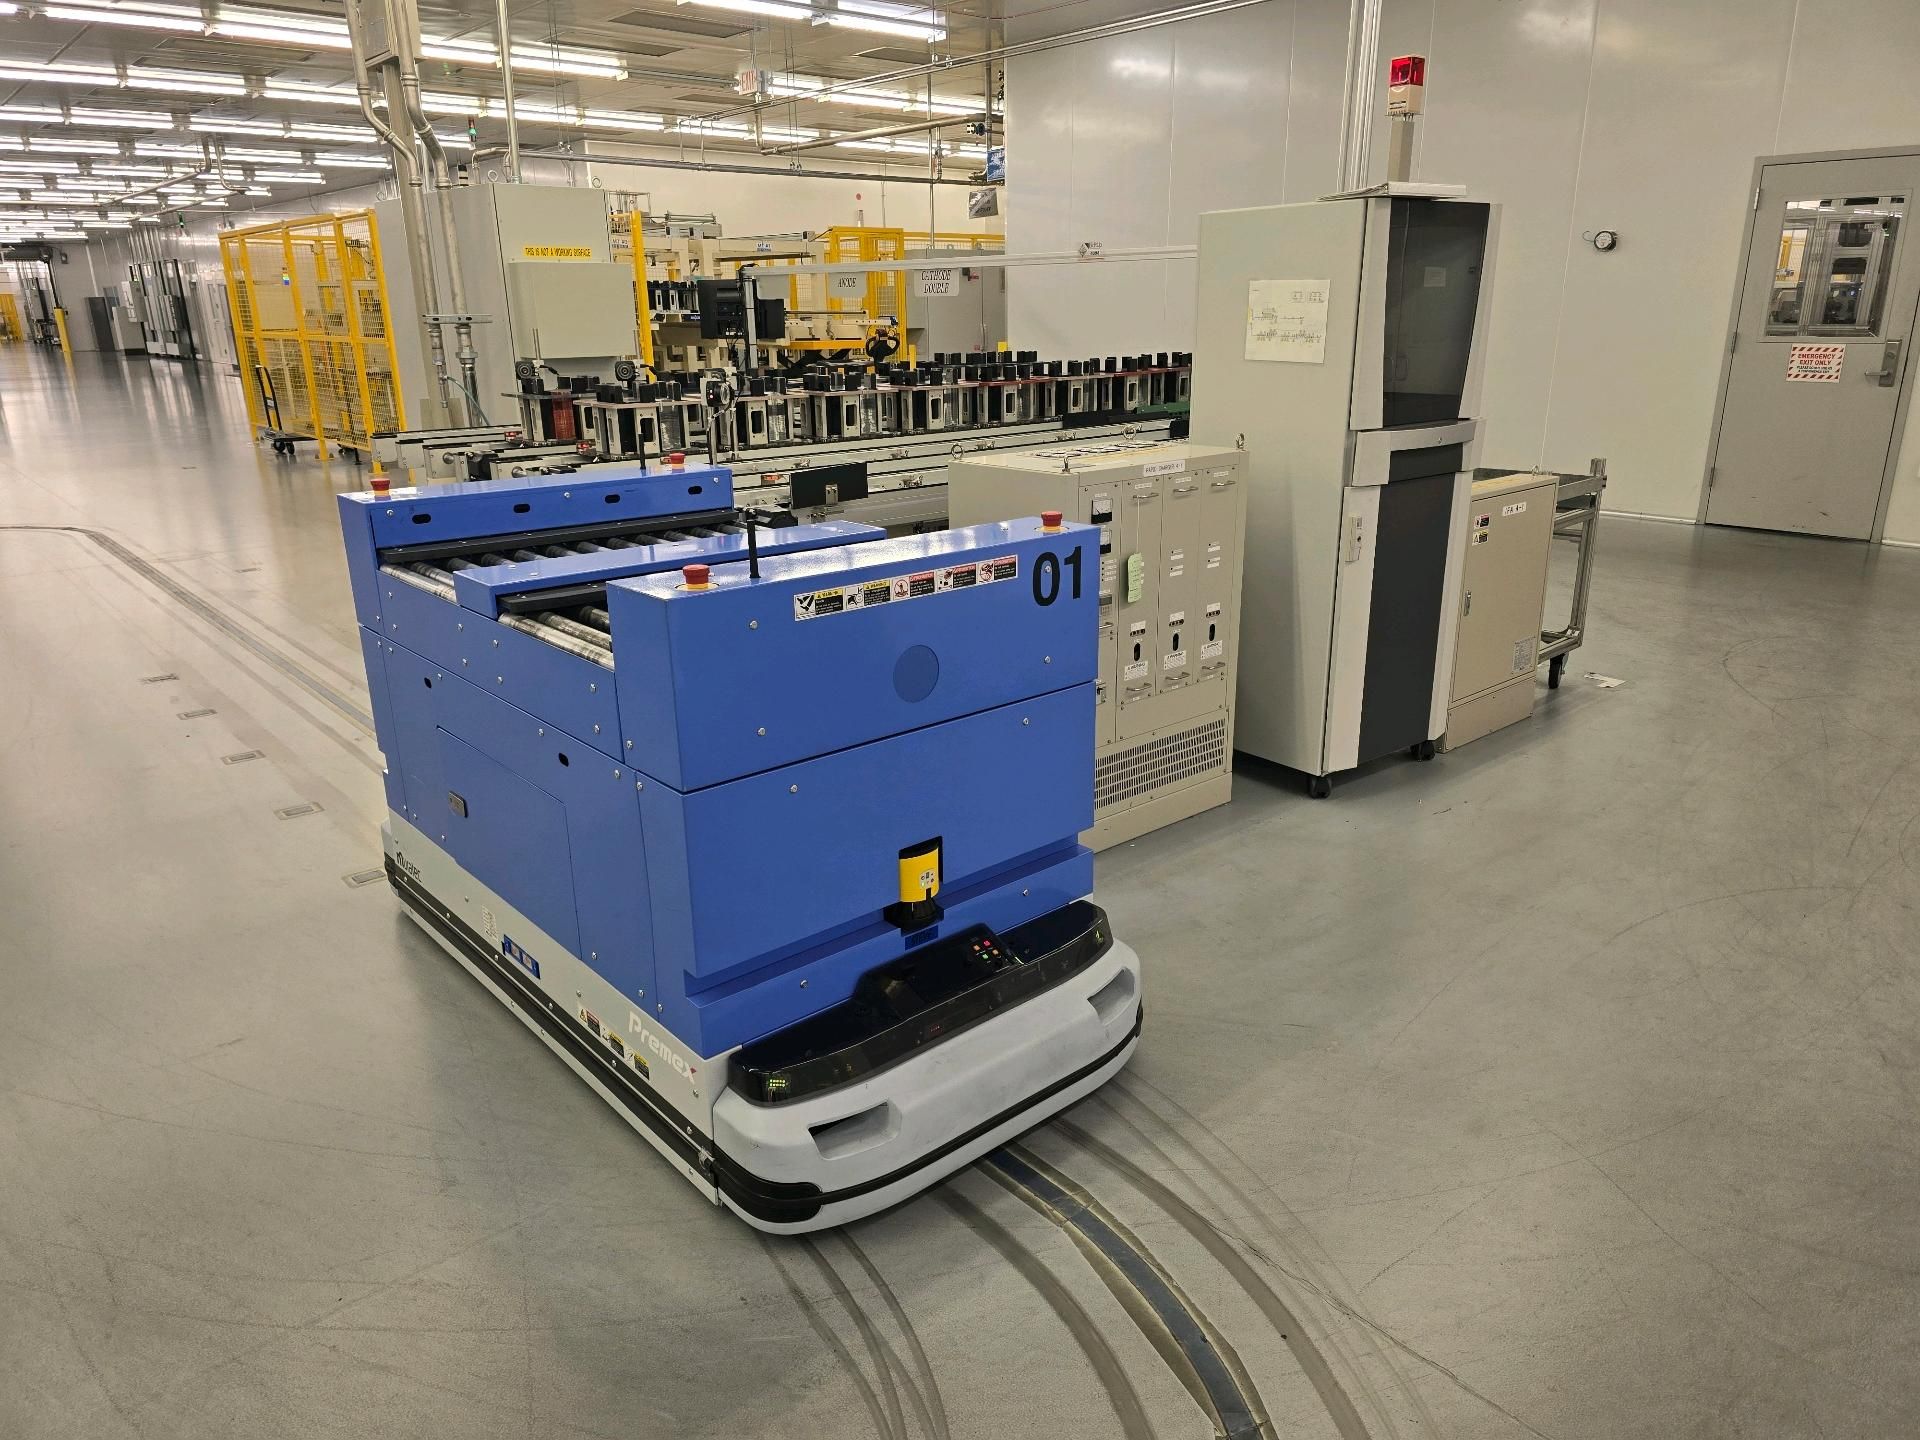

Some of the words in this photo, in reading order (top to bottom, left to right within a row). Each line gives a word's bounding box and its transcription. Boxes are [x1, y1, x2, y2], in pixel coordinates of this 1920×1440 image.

[525, 247, 535, 256] THIS
[535, 247, 540, 256] IS
[541, 247, 549, 257] NOT
[555, 248, 573, 257] WORKING
[921, 269, 952, 281] CATHODE
[837, 277, 857, 288] ANODE
[924, 282, 950, 294] DOUBLE
[1032, 545, 1083, 606] 01
